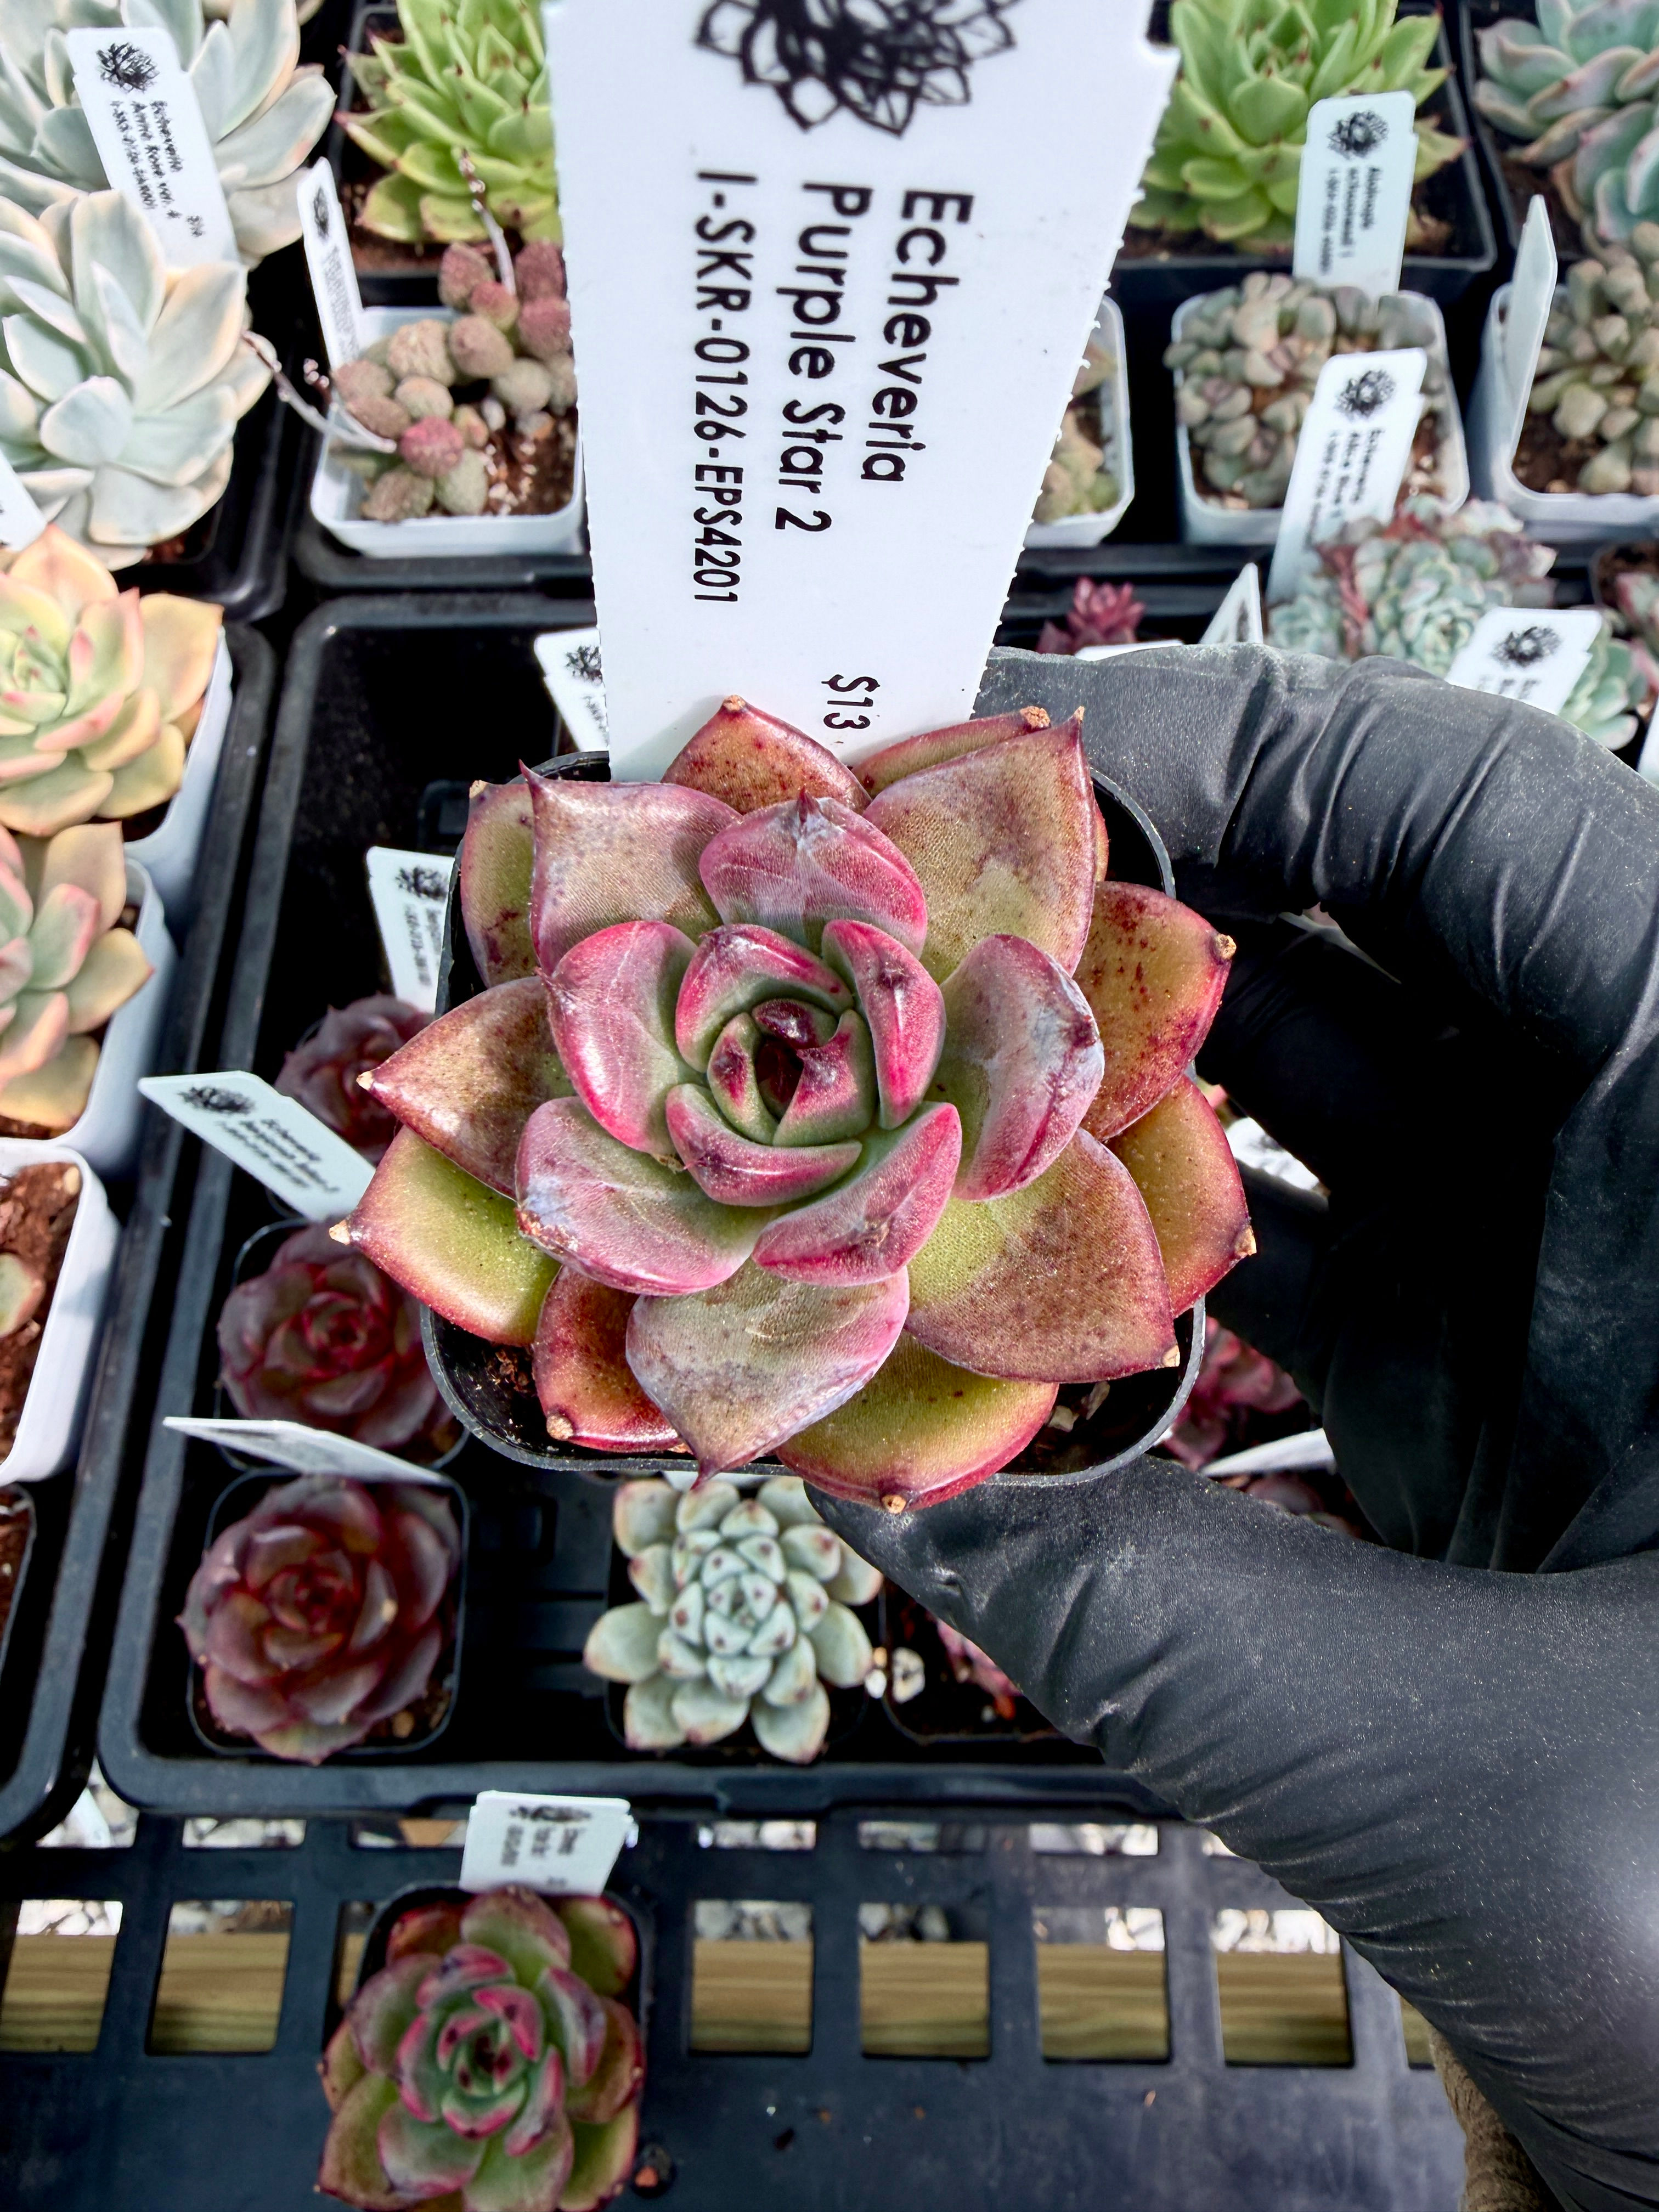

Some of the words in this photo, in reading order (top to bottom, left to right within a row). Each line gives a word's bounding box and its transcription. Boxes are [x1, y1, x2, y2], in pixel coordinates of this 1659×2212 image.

[775, 182, 874, 380] Purple
[860, 189, 975, 482] Echeveria
[692, 171, 758, 603] I-SKR-0126-EPS4201
[777, 398, 847, 494] Star
[774, 506, 833, 533] 2
[820, 673, 881, 730] $13
